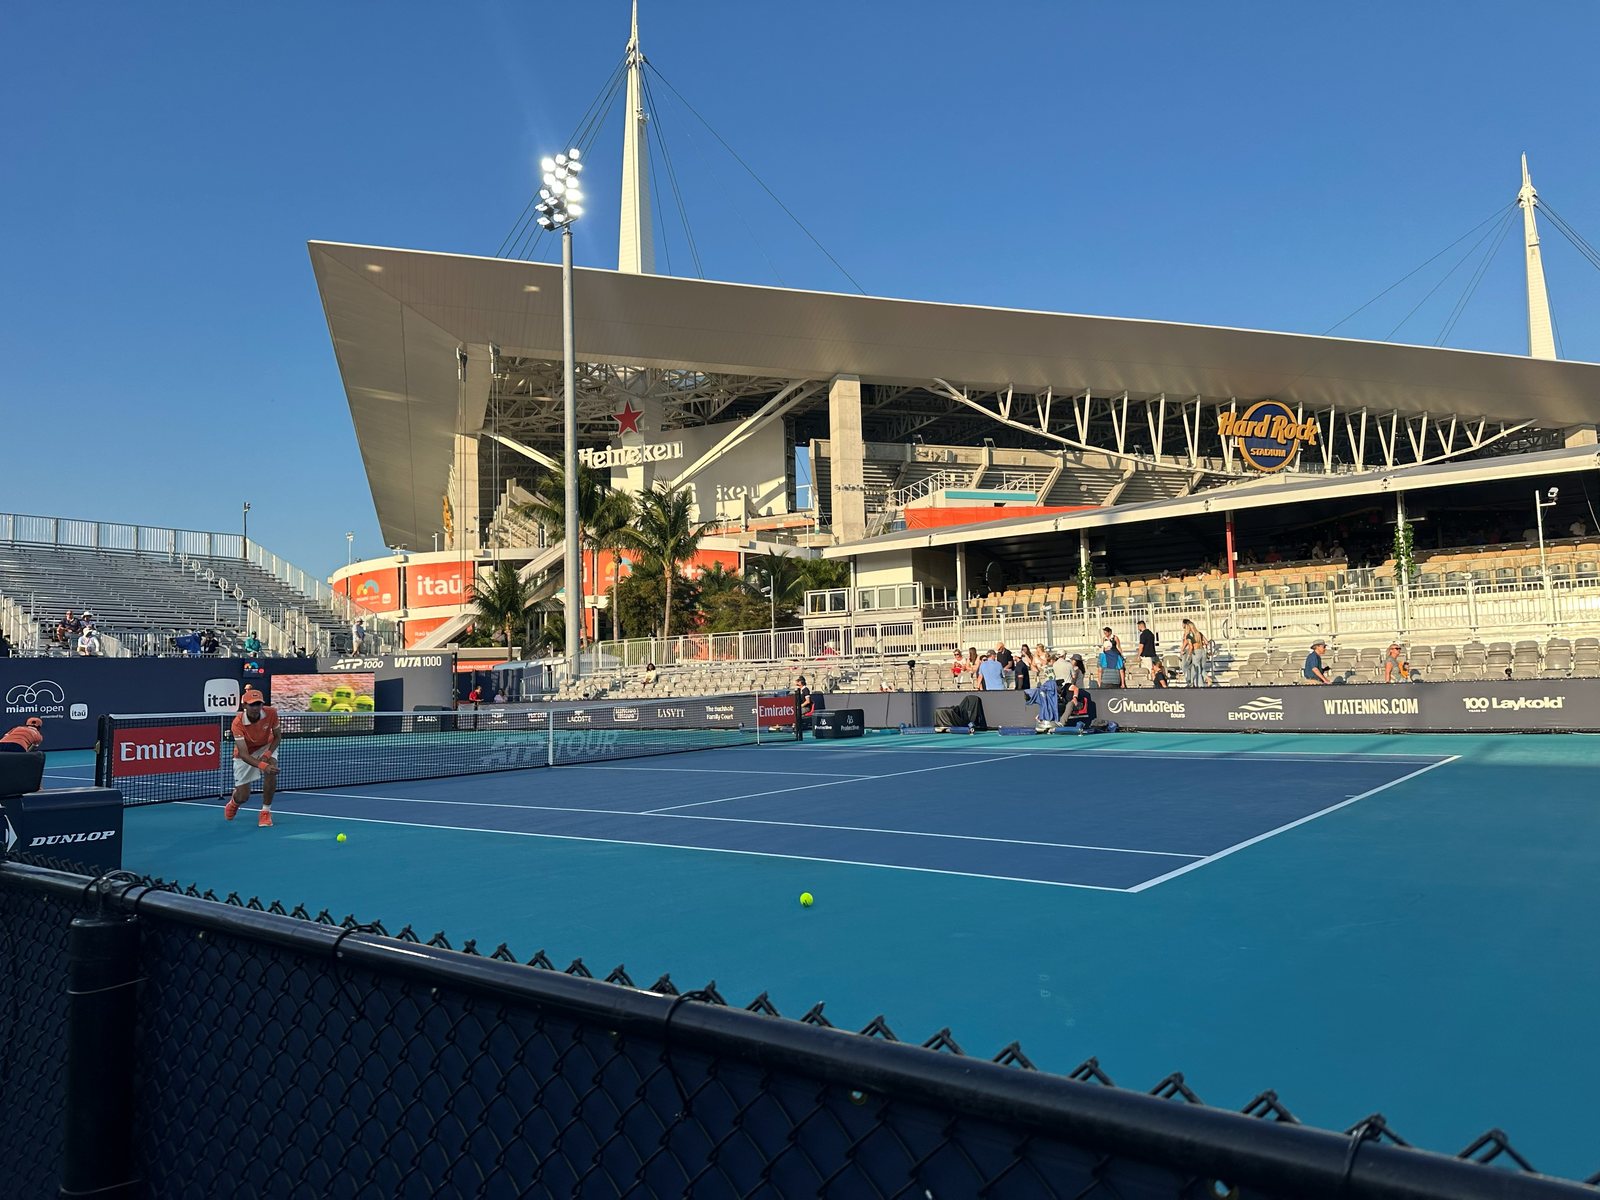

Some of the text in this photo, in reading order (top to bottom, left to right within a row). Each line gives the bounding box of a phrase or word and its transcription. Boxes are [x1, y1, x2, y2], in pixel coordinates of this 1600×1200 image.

[1217, 411, 1319, 446] Hard Rock
[577, 441, 683, 469] Heineken
[1250, 448, 1286, 457] STADIUM
[416, 574, 463, 596] itaú
[330, 658, 384, 670] ATP 1000
[394, 656, 442, 668] WTA 1000
[207, 693, 237, 707] itaú
[1324, 698, 1418, 715] WTATENNIS.COM
[1463, 697, 1563, 711] 100 Laykold
[6, 704, 64, 714] miami open
[759, 705, 795, 717] Emirates
[1228, 712, 1283, 721] EMPOWER
[119, 738, 216, 762] Emirates
[29, 830, 116, 847] DUNLOP
